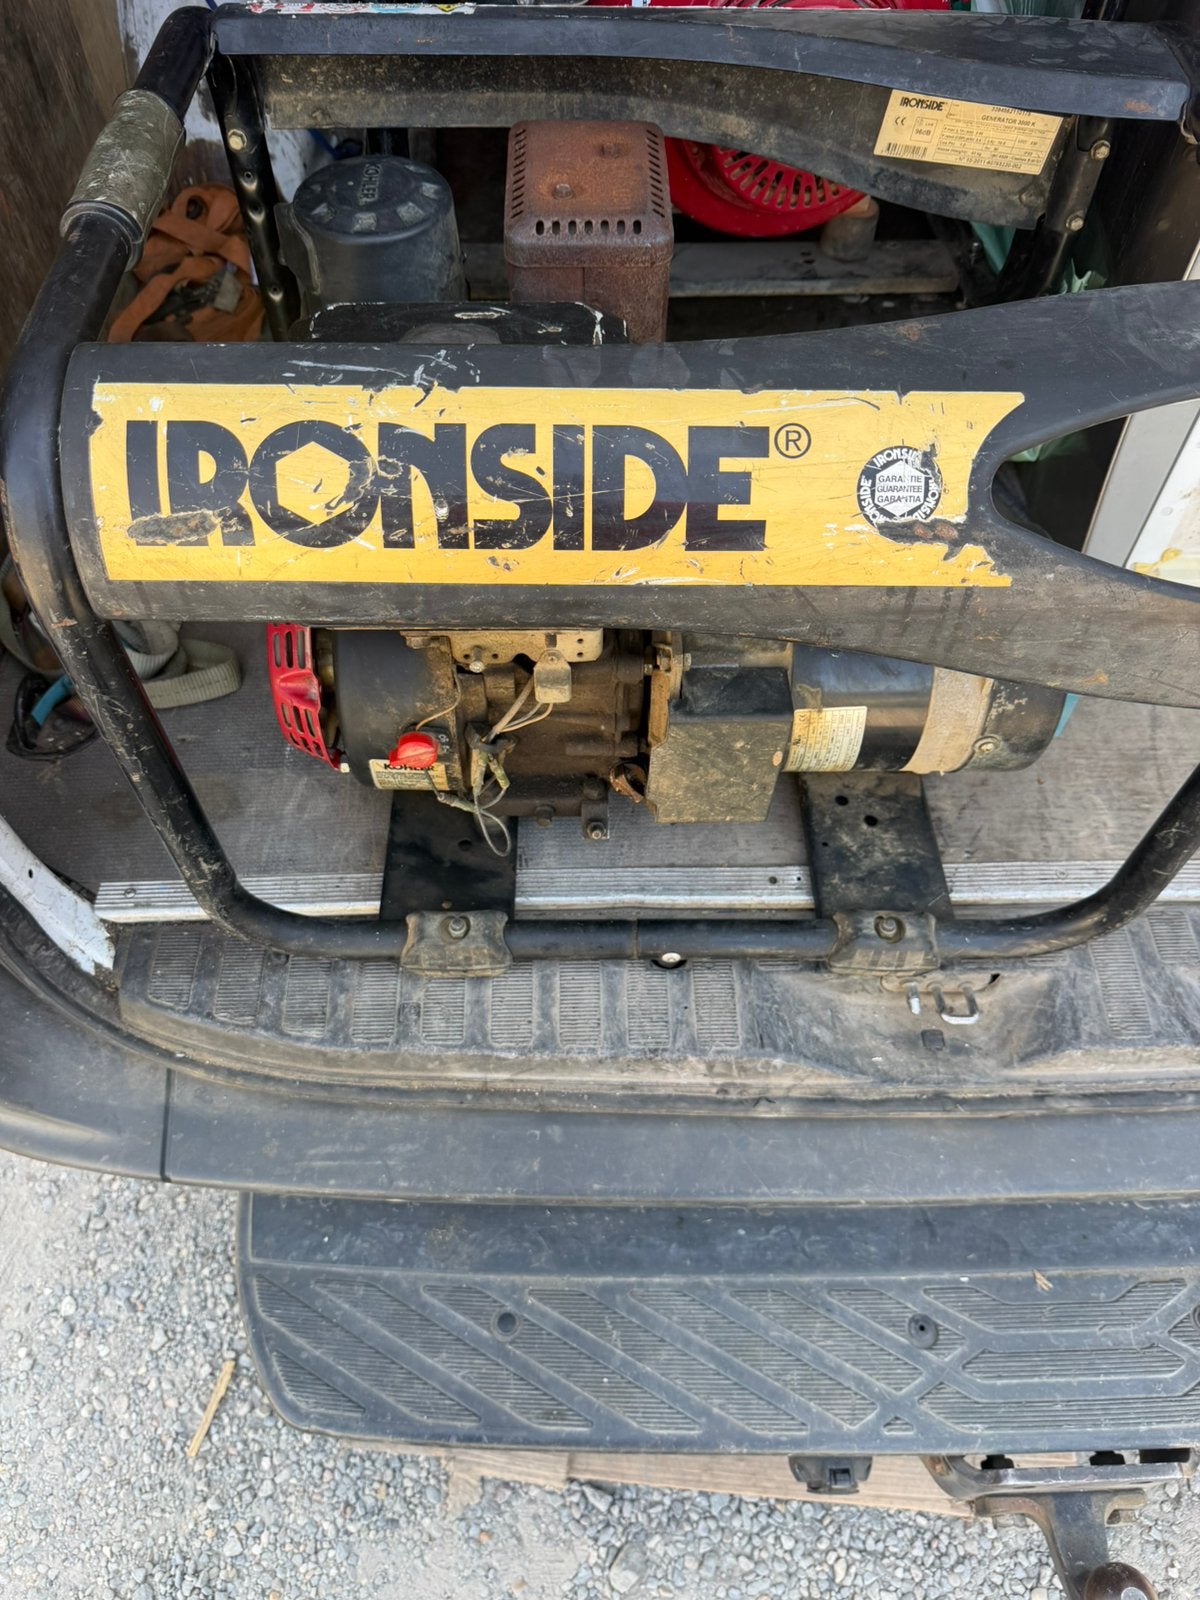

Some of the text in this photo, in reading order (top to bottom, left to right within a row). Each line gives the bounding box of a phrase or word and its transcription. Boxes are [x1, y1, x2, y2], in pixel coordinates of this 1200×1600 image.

[900, 96, 944, 111] IRONSIDE
[981, 114, 1018, 126] GENERATOR
[359, 162, 383, 205] KOHLER
[126, 419, 770, 551] IRONSIDE
[878, 475, 922, 483] GARATIE
[877, 485, 922, 493] GUARANTEE
